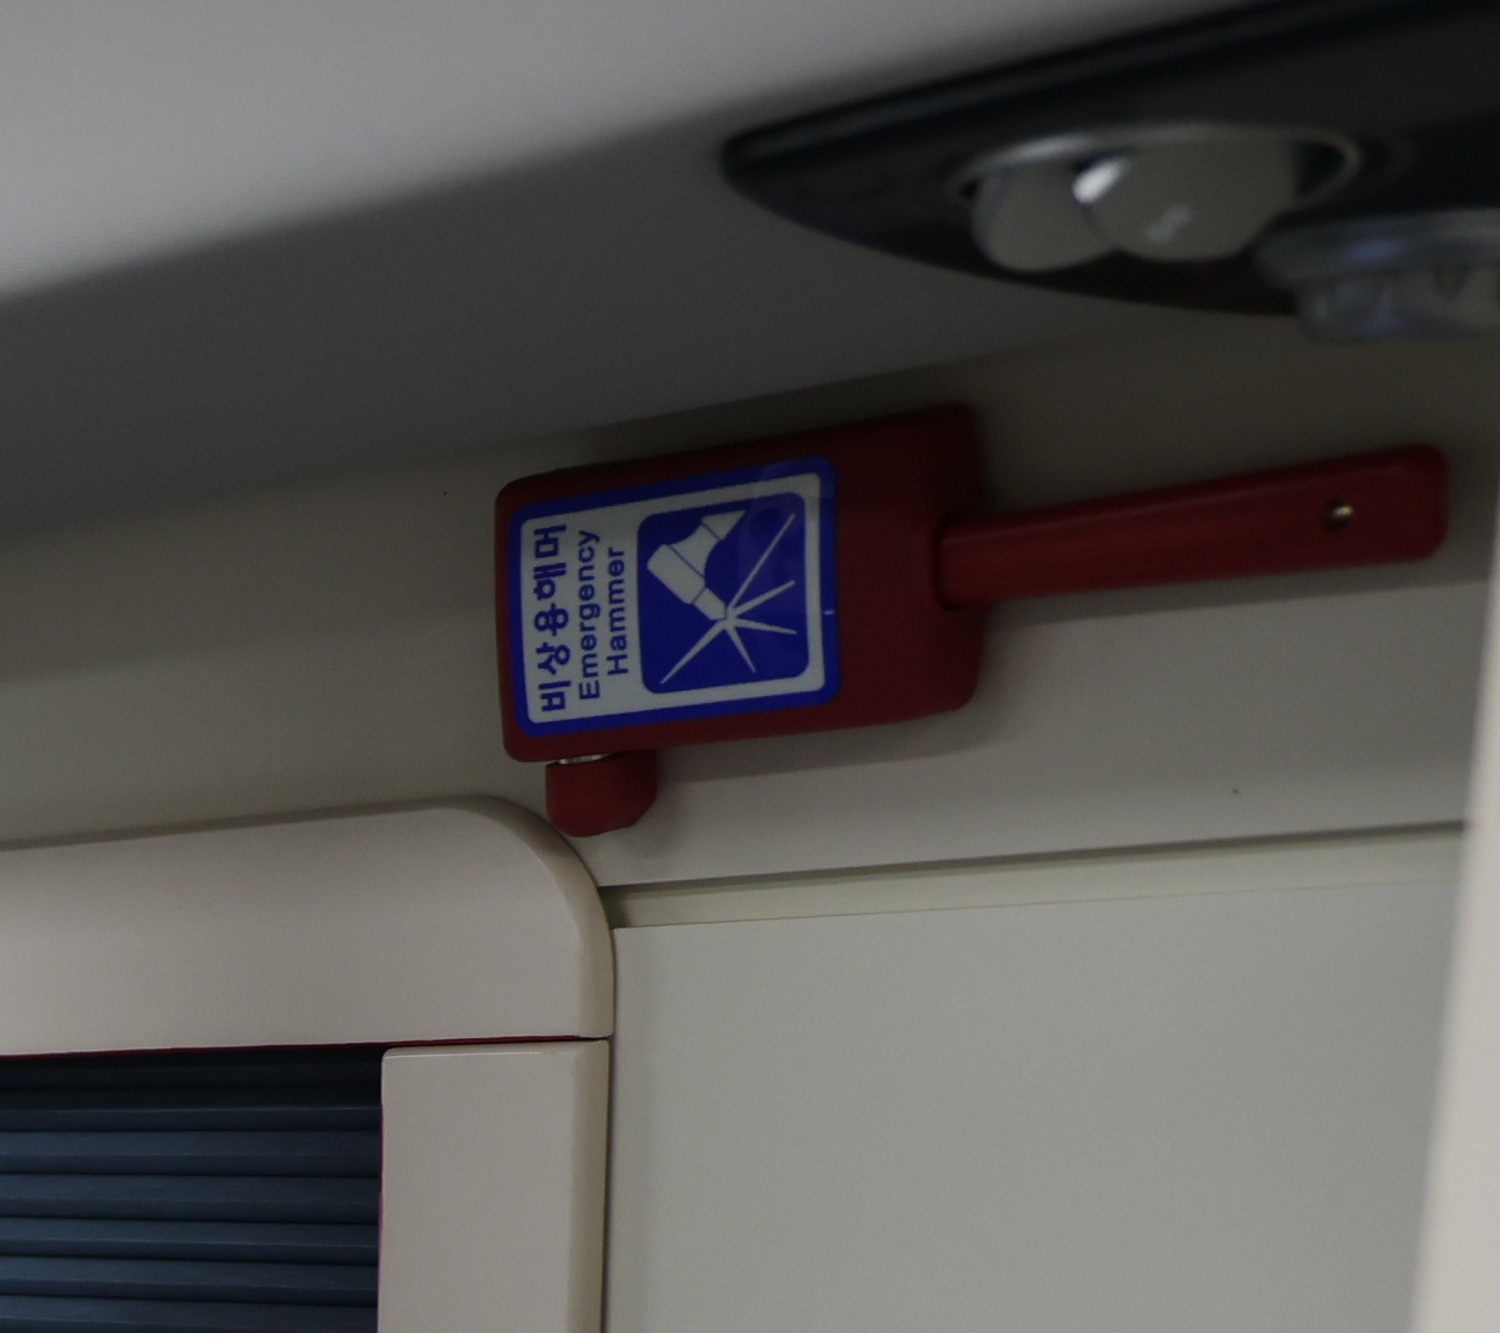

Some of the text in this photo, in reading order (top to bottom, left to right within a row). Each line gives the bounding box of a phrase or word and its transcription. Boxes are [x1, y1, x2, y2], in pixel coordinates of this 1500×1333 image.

[533, 524, 571, 712] 비상용해머
[578, 529, 601, 700] Emergency
[607, 547, 629, 675] Hammer
